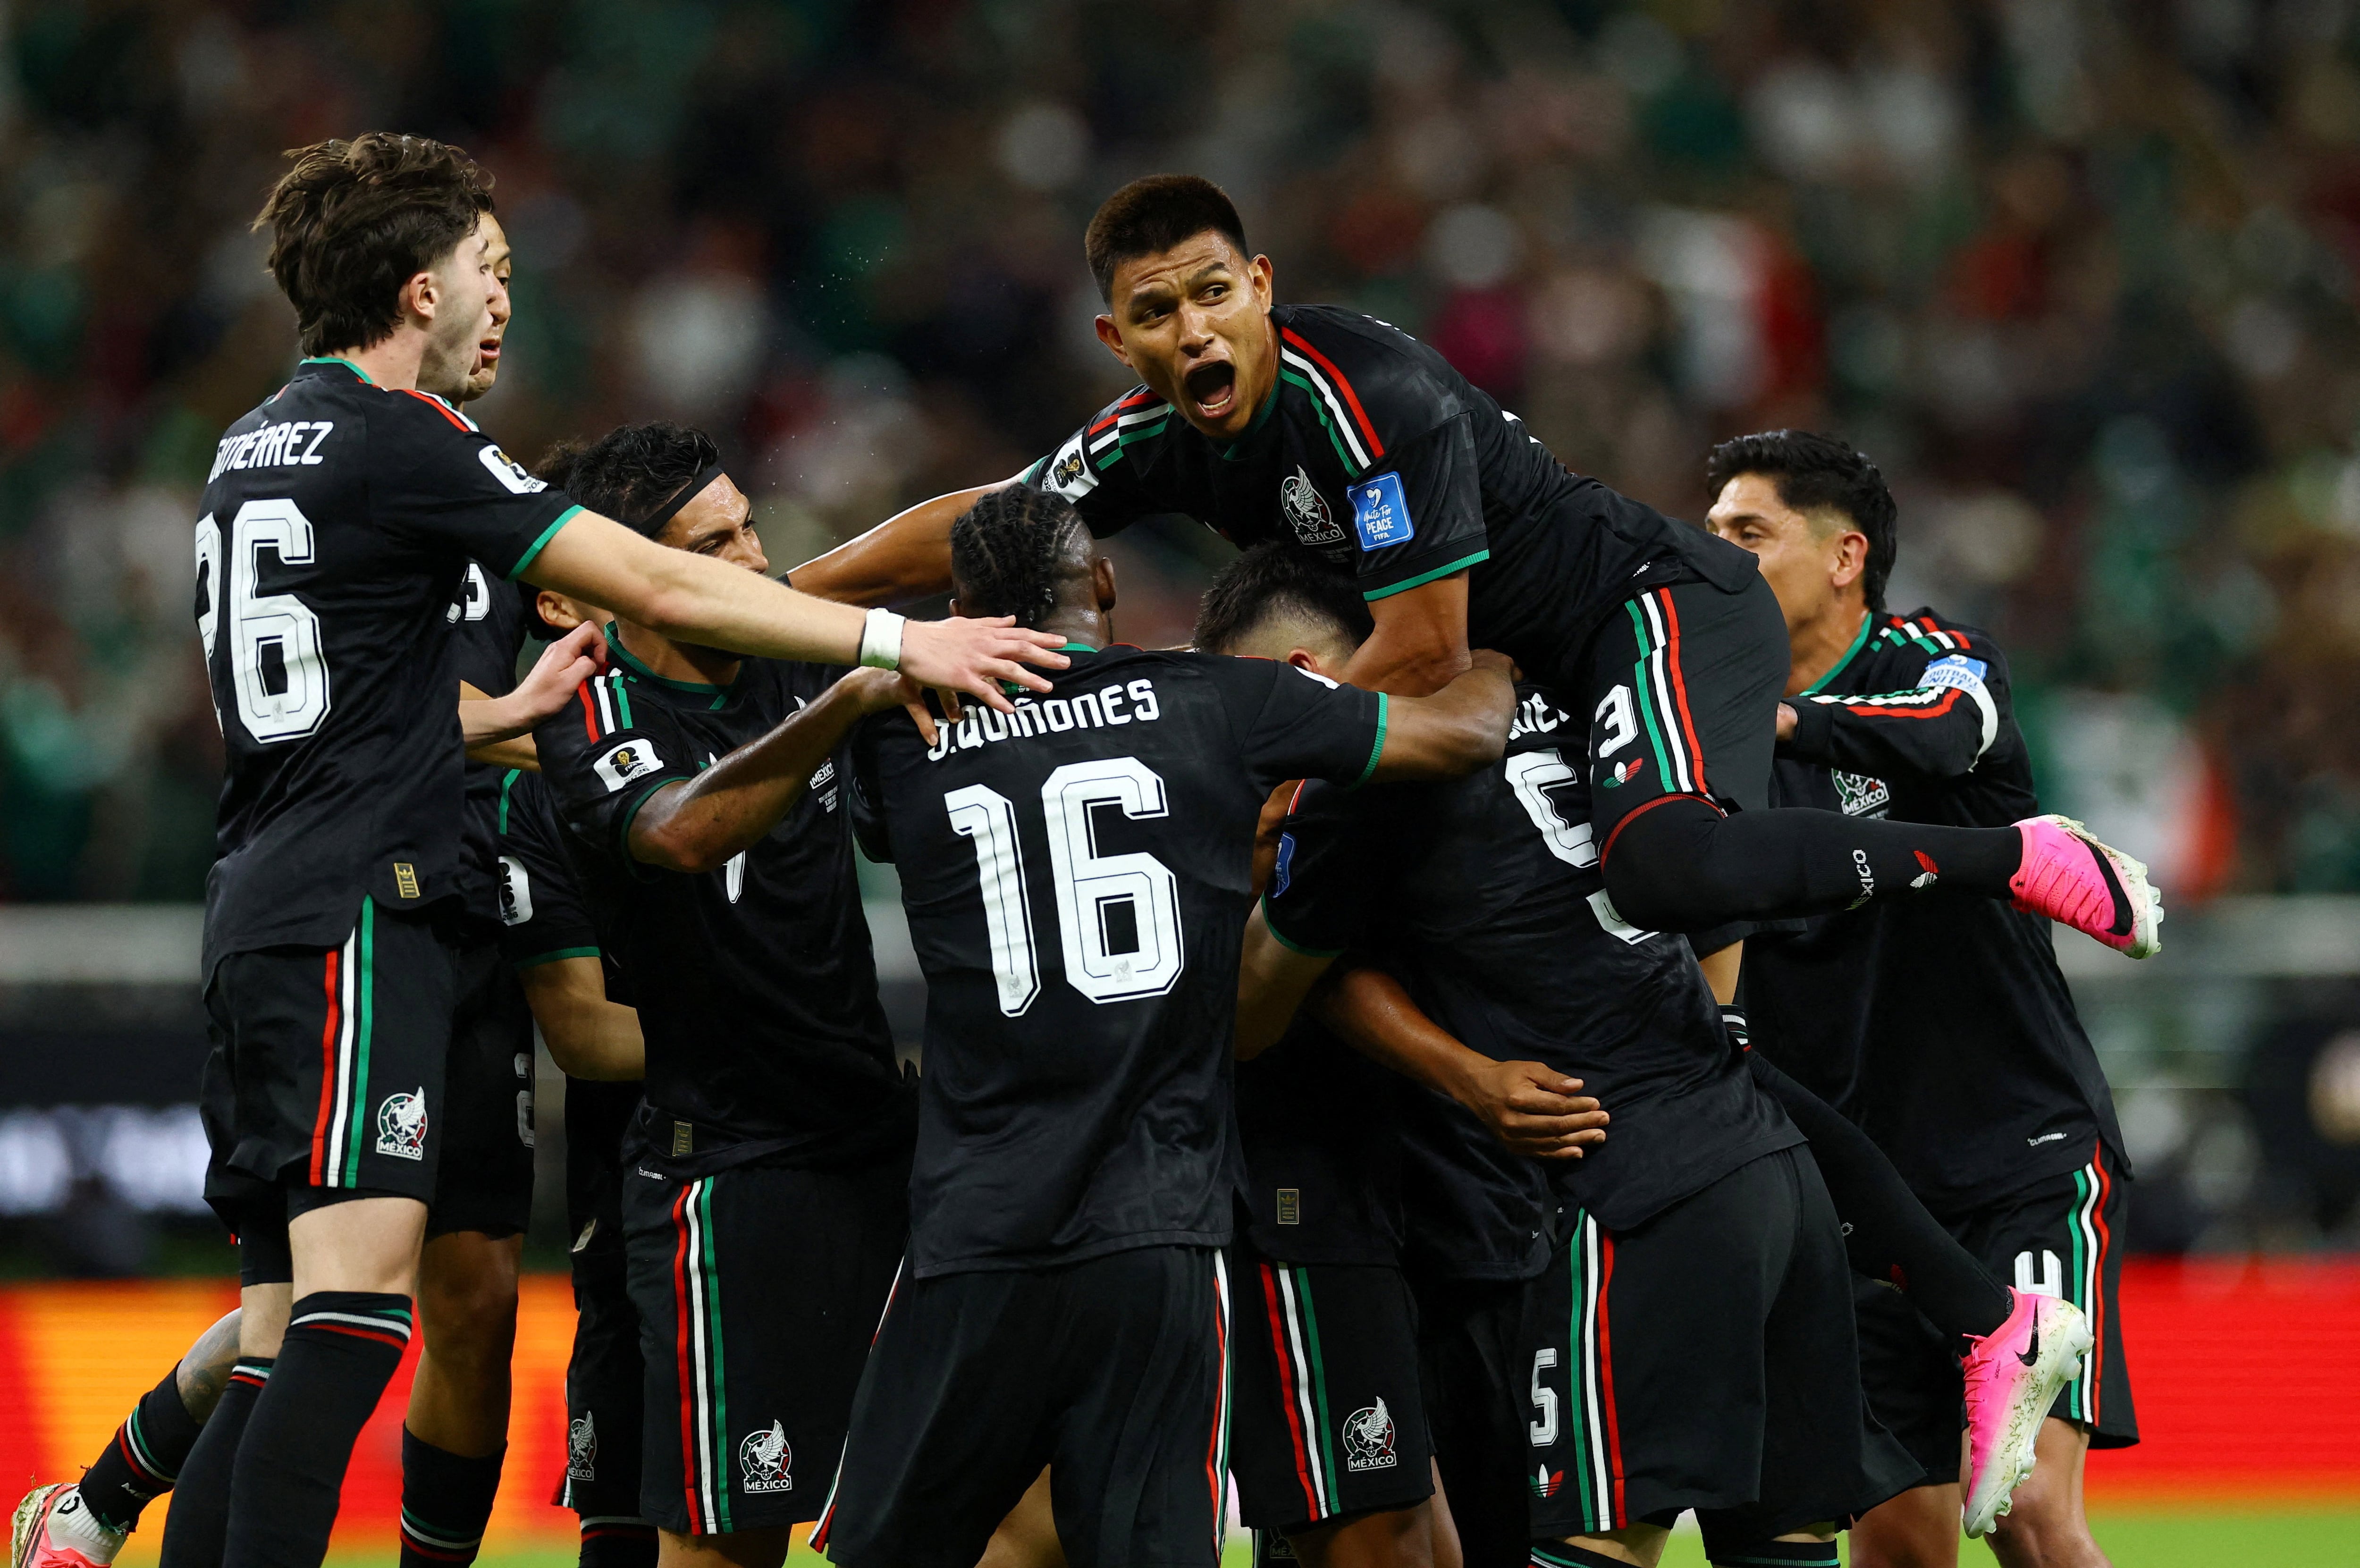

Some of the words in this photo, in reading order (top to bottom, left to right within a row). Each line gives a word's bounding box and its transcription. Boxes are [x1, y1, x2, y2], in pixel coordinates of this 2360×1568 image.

[1364, 509, 1380, 522] Unite
[1379, 505, 1391, 518] For
[1365, 517, 1394, 534] PEACE
[1299, 529, 1340, 542] MÉXICO
[1373, 532, 1390, 541] FIFA
[944, 756, 1184, 1018] 16
[380, 1140, 421, 1156] MÉXICO
[1530, 1348, 1558, 1447] 5
[1350, 1455, 1394, 1469] MÉXICO
[746, 1479, 789, 1491] MÉXICO
